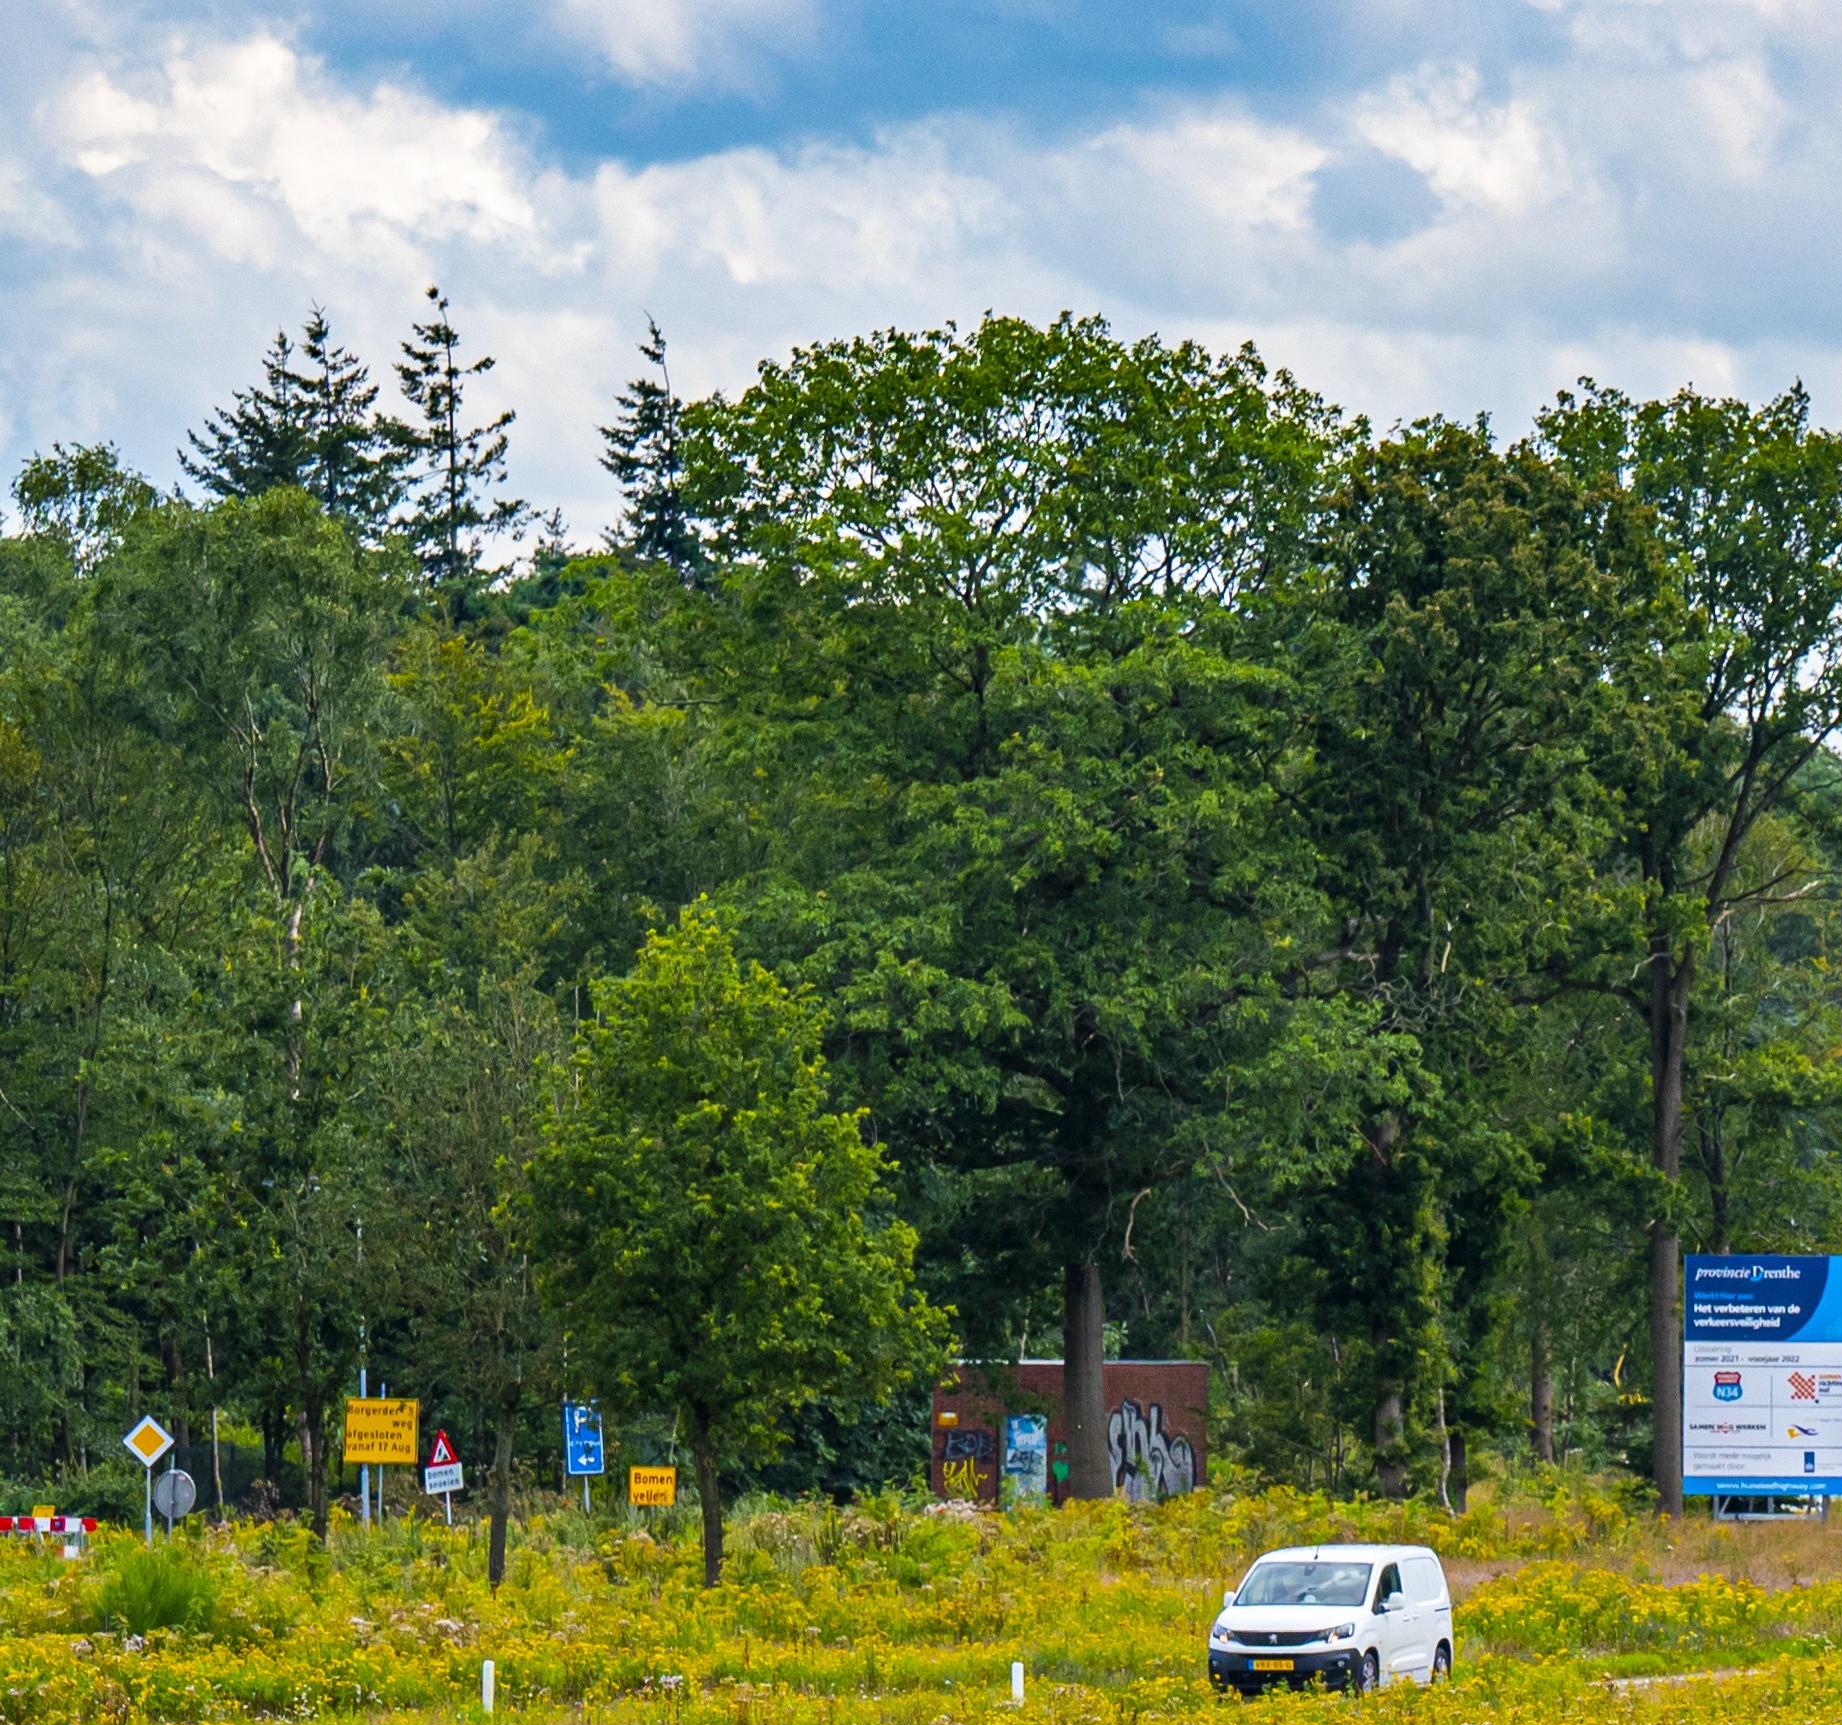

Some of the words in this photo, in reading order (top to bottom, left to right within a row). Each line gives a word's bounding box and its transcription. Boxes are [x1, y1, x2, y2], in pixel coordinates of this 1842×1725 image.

[1751, 1265, 1801, 1282] Drenthe
[1694, 1304, 1712, 1314] Het
[1713, 1303, 1766, 1314] verbeteren
[1768, 1305, 1785, 1314] van
[1788, 1304, 1800, 1314] de
[1693, 1316, 1780, 1330] verkeersveiligheid
[1717, 1387, 1738, 1398] N34
[392, 1420, 412, 1430] weg
[347, 1442, 374, 1452] vanaf
[379, 1443, 388, 1452] 17
[634, 1472, 673, 1485] Bomen
